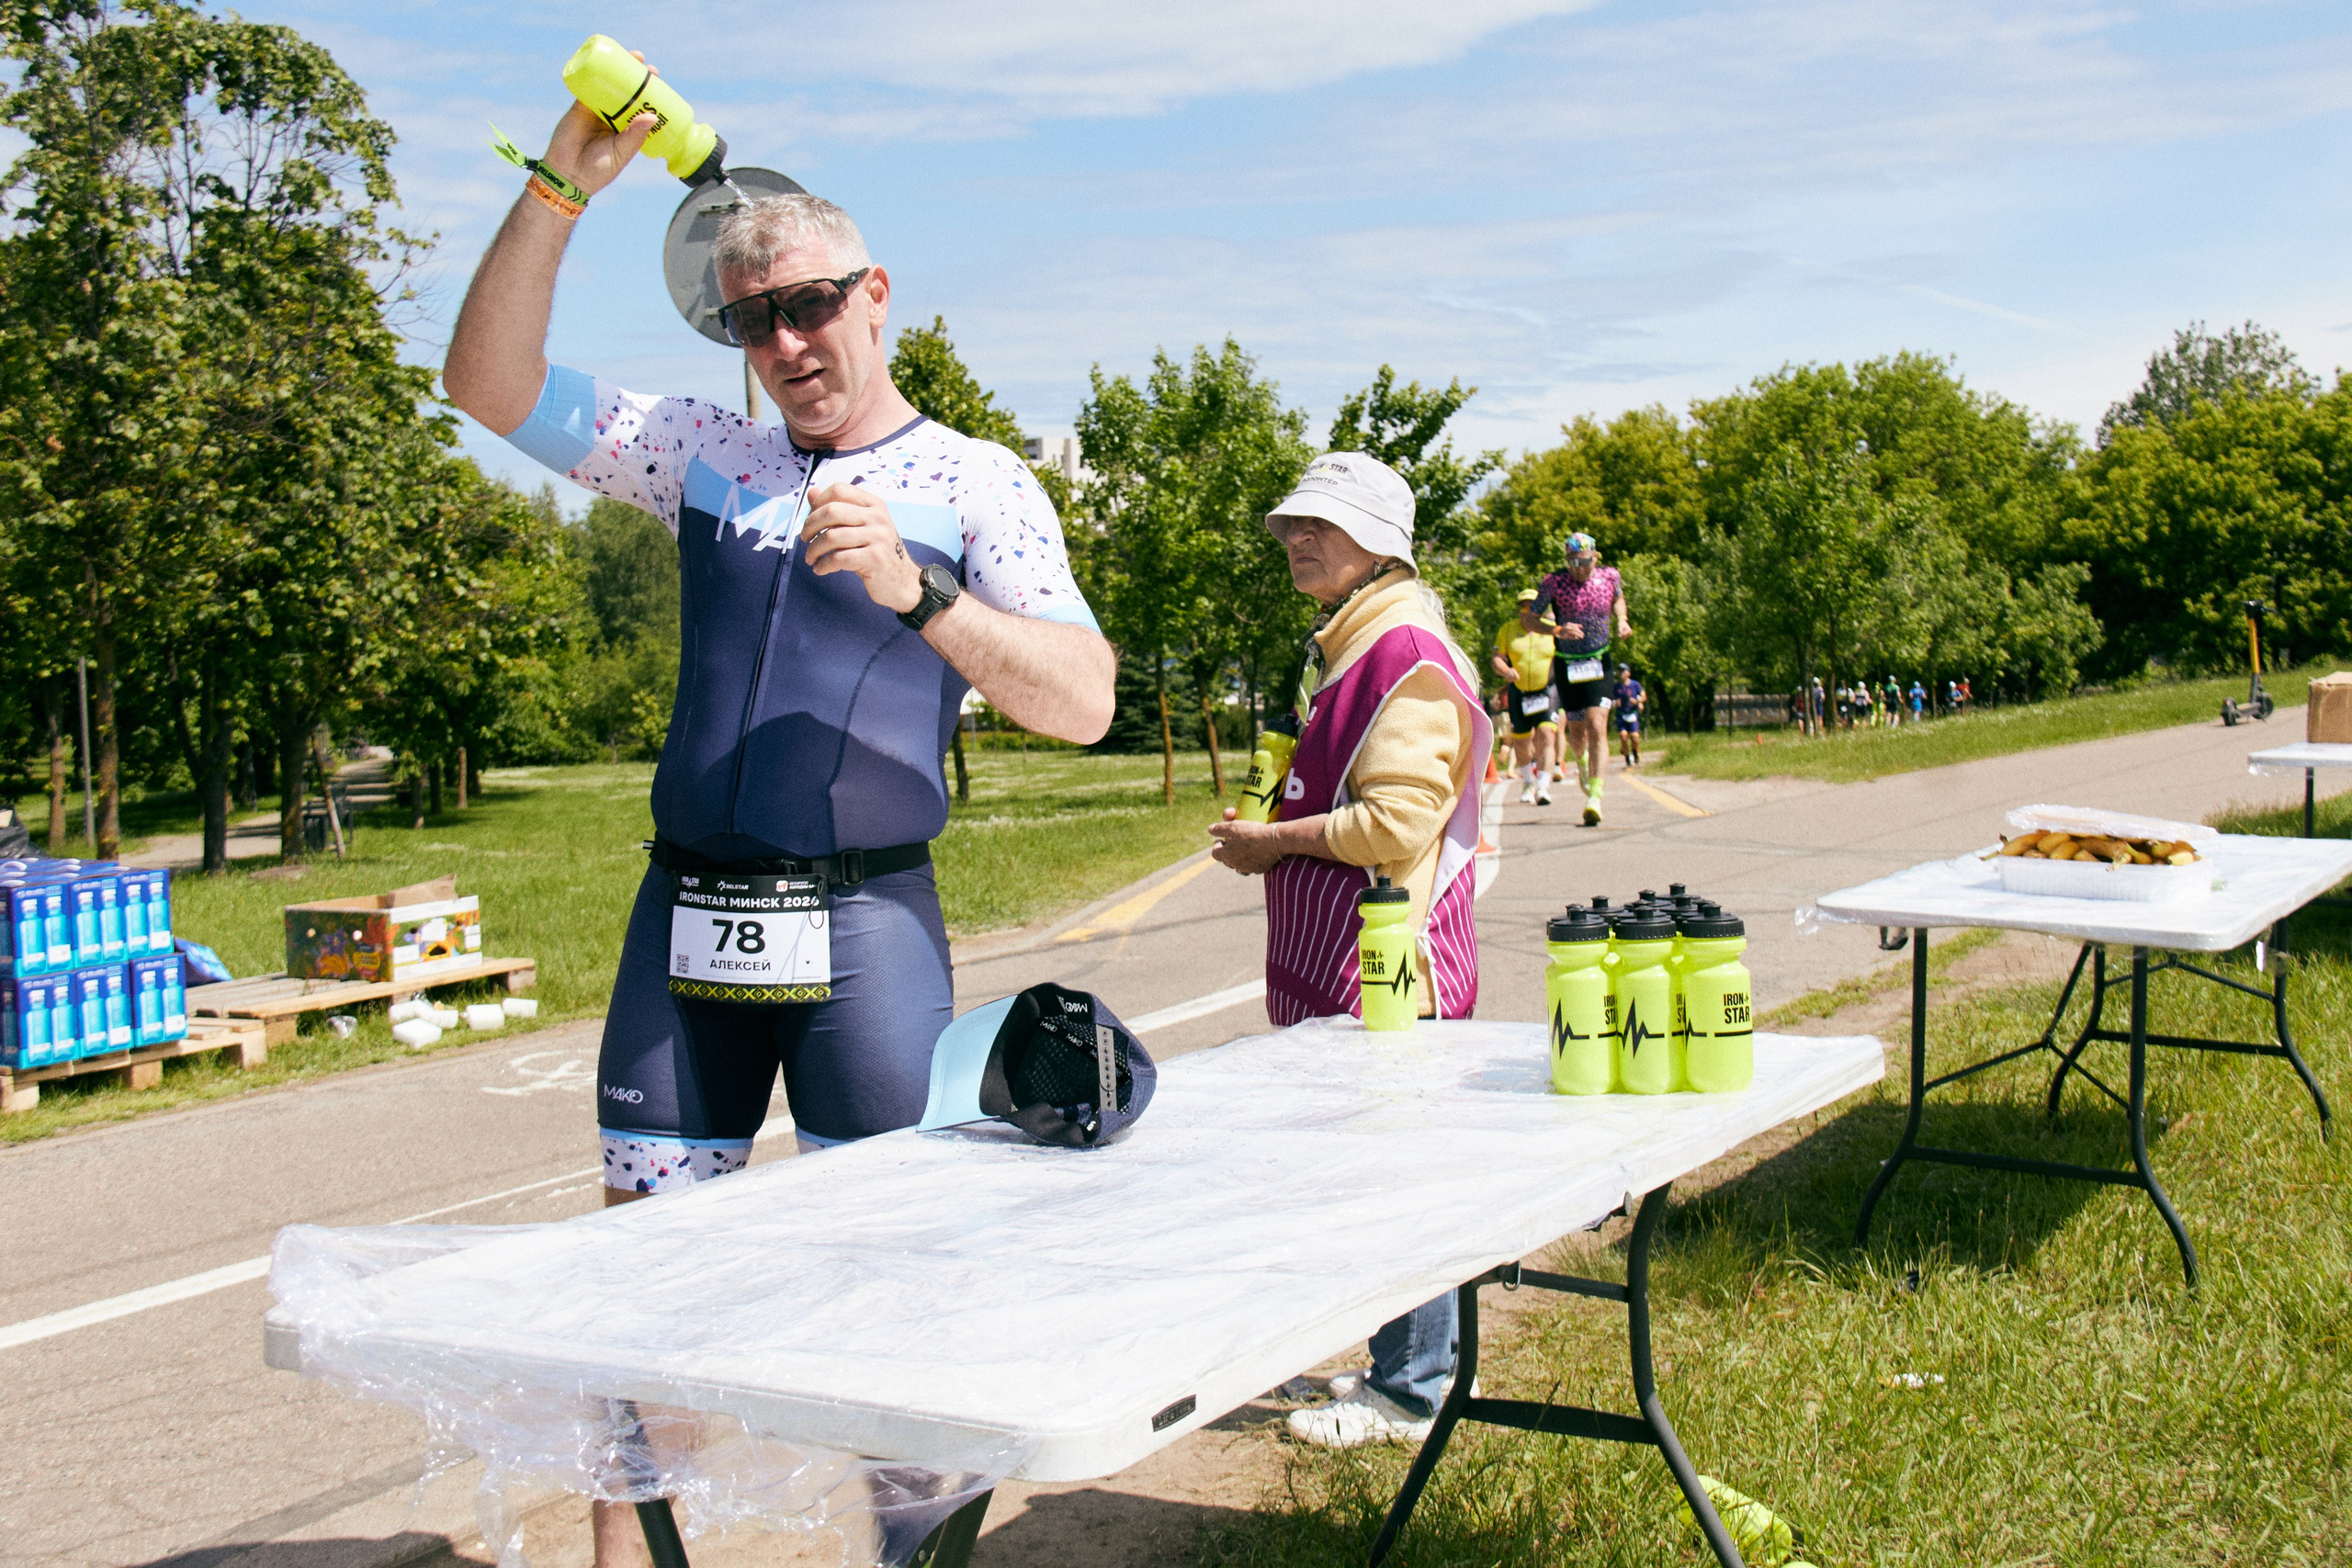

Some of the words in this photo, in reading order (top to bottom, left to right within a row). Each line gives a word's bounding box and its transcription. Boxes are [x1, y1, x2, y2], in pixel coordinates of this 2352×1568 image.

[680, 891, 726, 907] IRONSTAR
[729, 897, 780, 908] МИНСК
[783, 896, 820, 908] 2026
[712, 919, 765, 954] 78
[709, 958, 771, 971] АЛЕКСЕЙ
[1363, 961, 1385, 975] STAR
[1724, 993, 1744, 1007] IRON
[1724, 1006, 1750, 1024] STAR
[604, 1084, 644, 1103] MAKO
